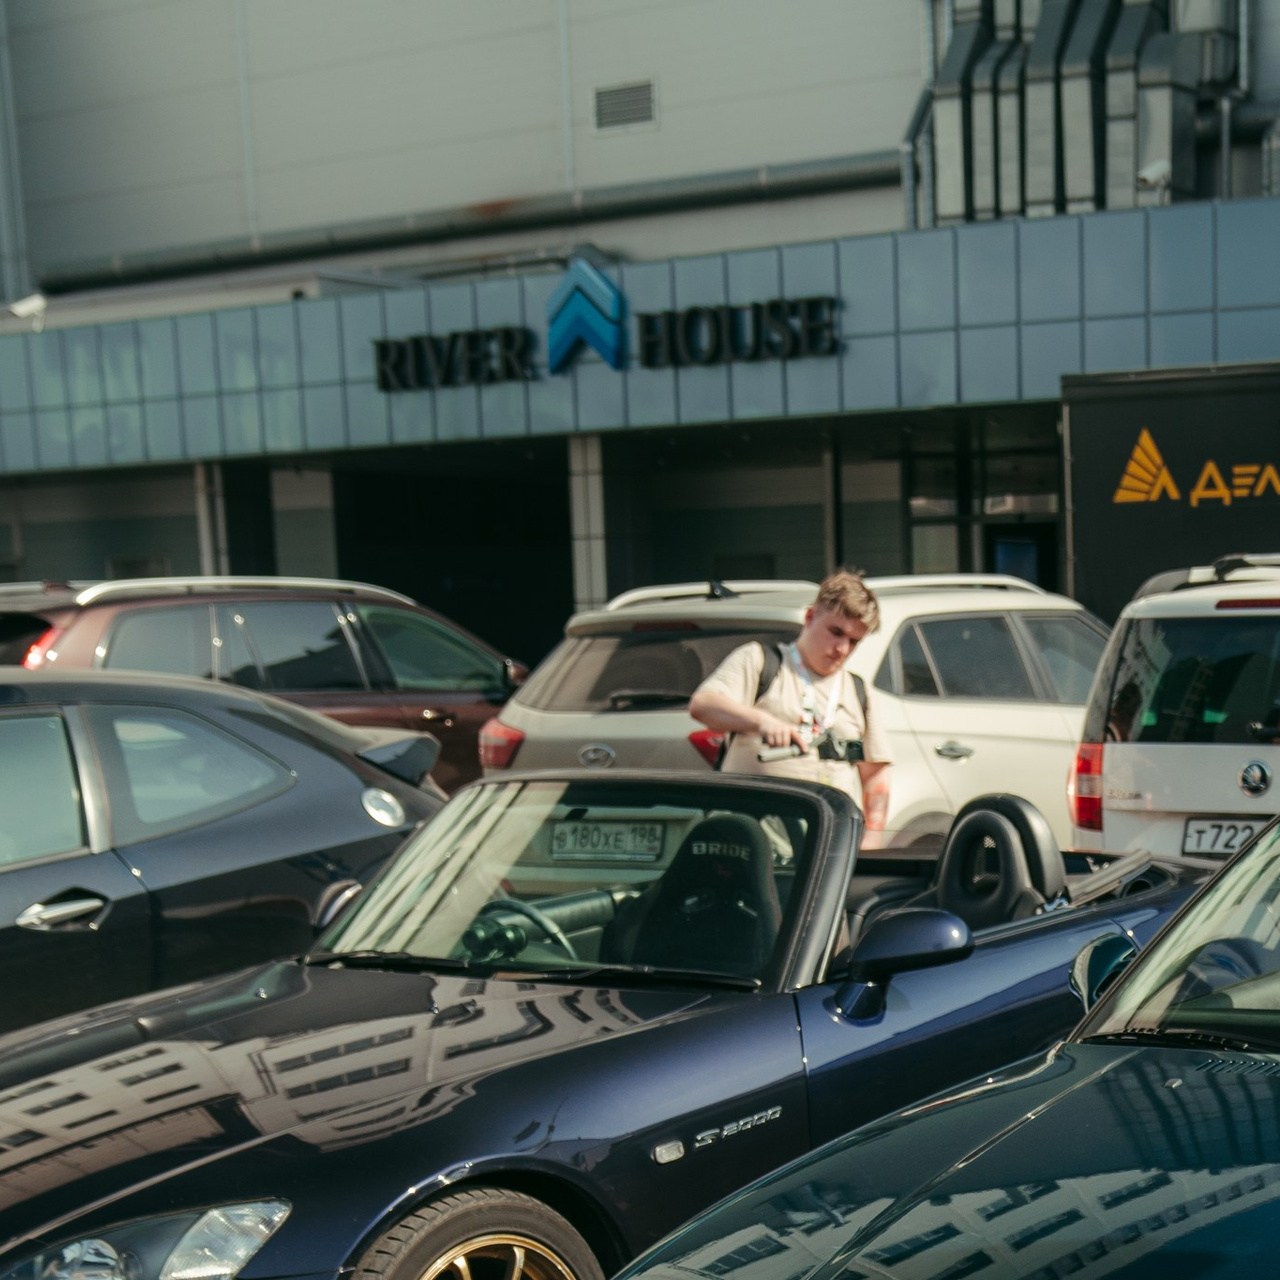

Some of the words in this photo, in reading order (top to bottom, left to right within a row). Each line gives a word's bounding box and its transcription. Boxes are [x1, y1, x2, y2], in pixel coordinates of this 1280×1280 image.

[373, 326, 535, 392] RIVER
[636, 297, 842, 369] HOUSE
[1194, 824, 1255, 850] Т722
[692, 841, 751, 861] BRIDE
